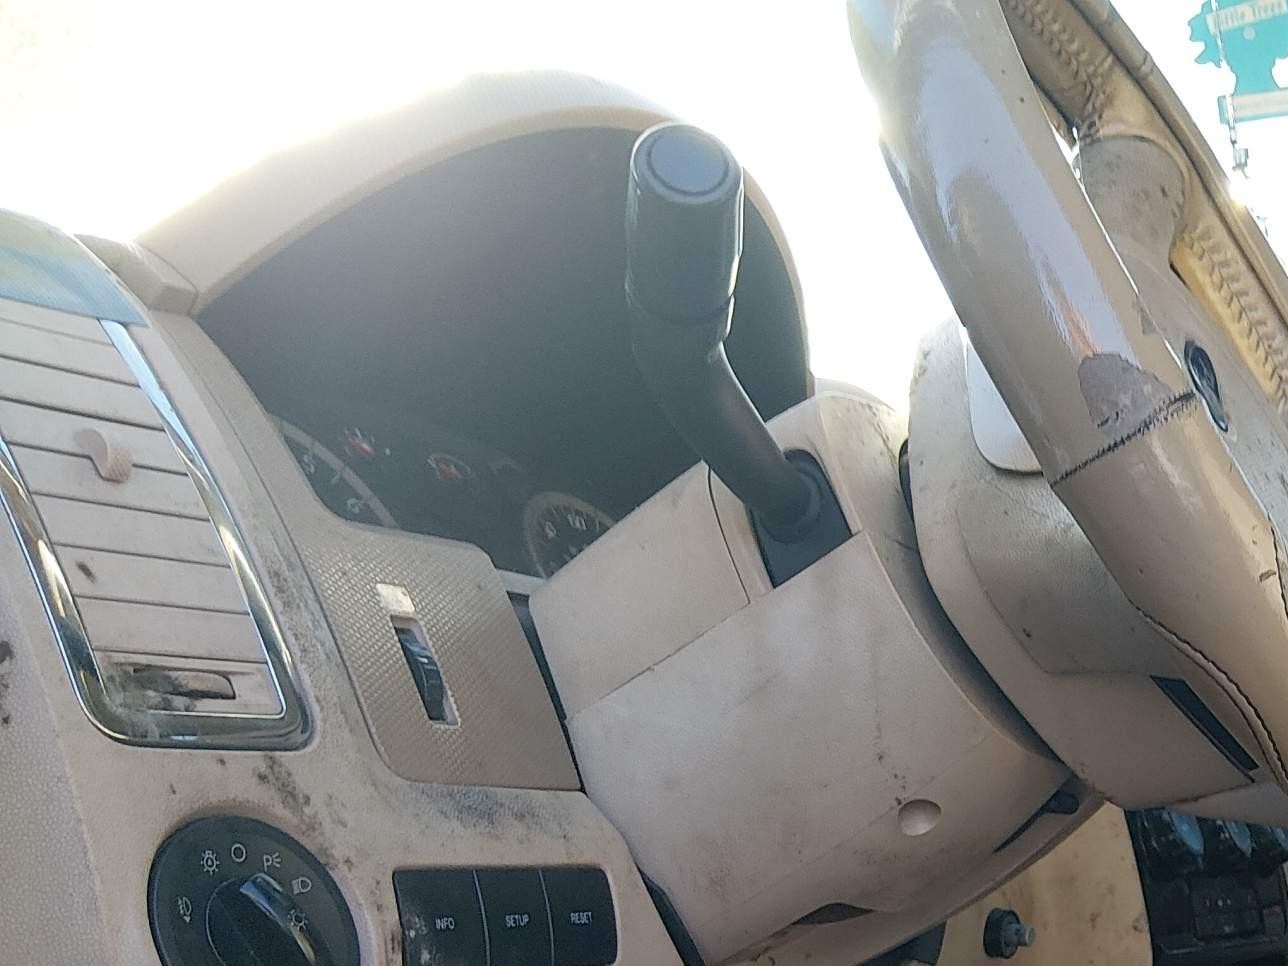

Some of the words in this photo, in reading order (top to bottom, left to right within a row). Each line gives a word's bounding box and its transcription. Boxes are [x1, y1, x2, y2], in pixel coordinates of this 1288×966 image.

[435, 917, 455, 930] INFO
[505, 914, 530, 928] SETUP
[570, 911, 593, 925] RESET
